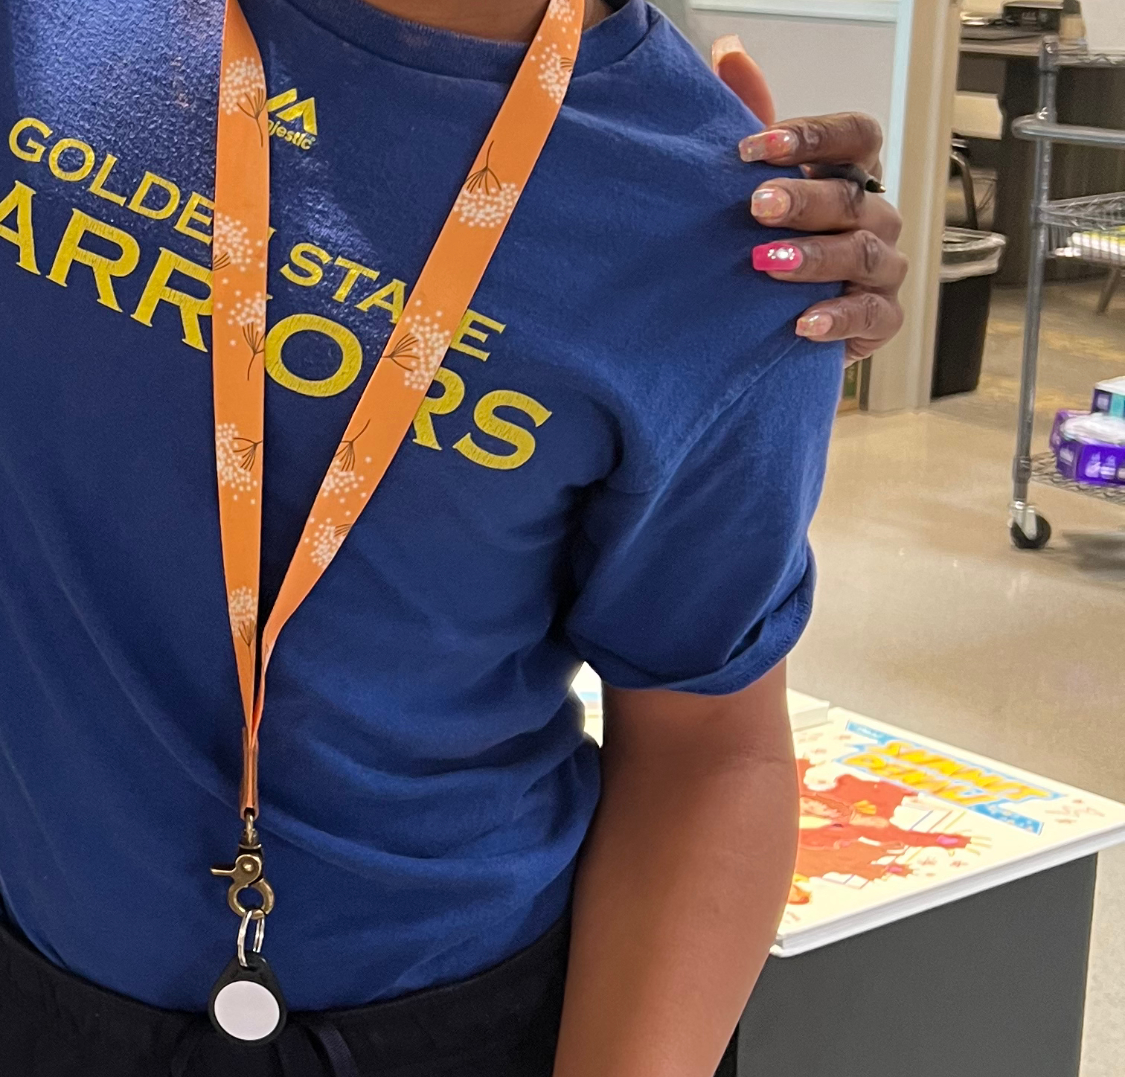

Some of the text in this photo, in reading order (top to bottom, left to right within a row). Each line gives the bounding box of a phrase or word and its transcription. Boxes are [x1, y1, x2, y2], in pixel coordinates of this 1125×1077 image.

[268, 119, 313, 150] jestic
[8, 116, 506, 362] GOLDE STAE
